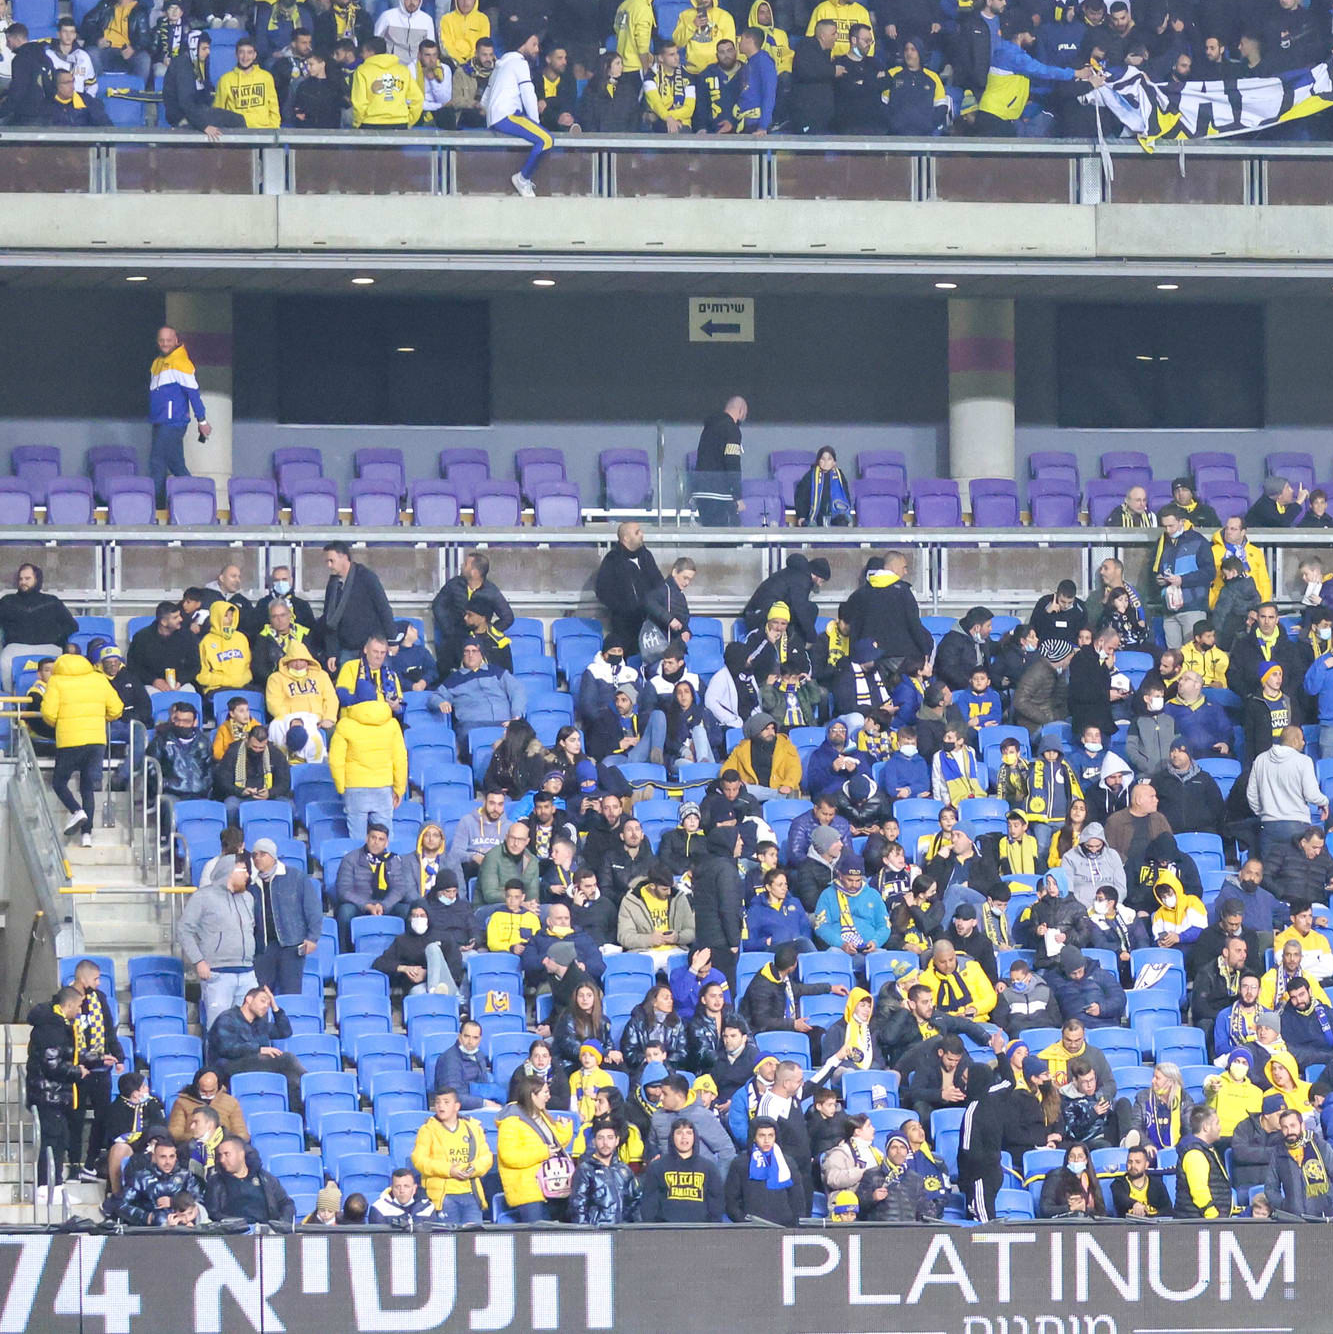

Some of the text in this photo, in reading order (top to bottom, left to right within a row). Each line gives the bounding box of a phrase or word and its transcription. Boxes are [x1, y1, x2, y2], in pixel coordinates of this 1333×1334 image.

[698, 303, 744, 314] שירותים
[667, 1173, 704, 1197] MACCABI FANATICS
[0, 1232, 614, 1334] הנשיא 74
[782, 1229, 1296, 1306] PLATINUM
